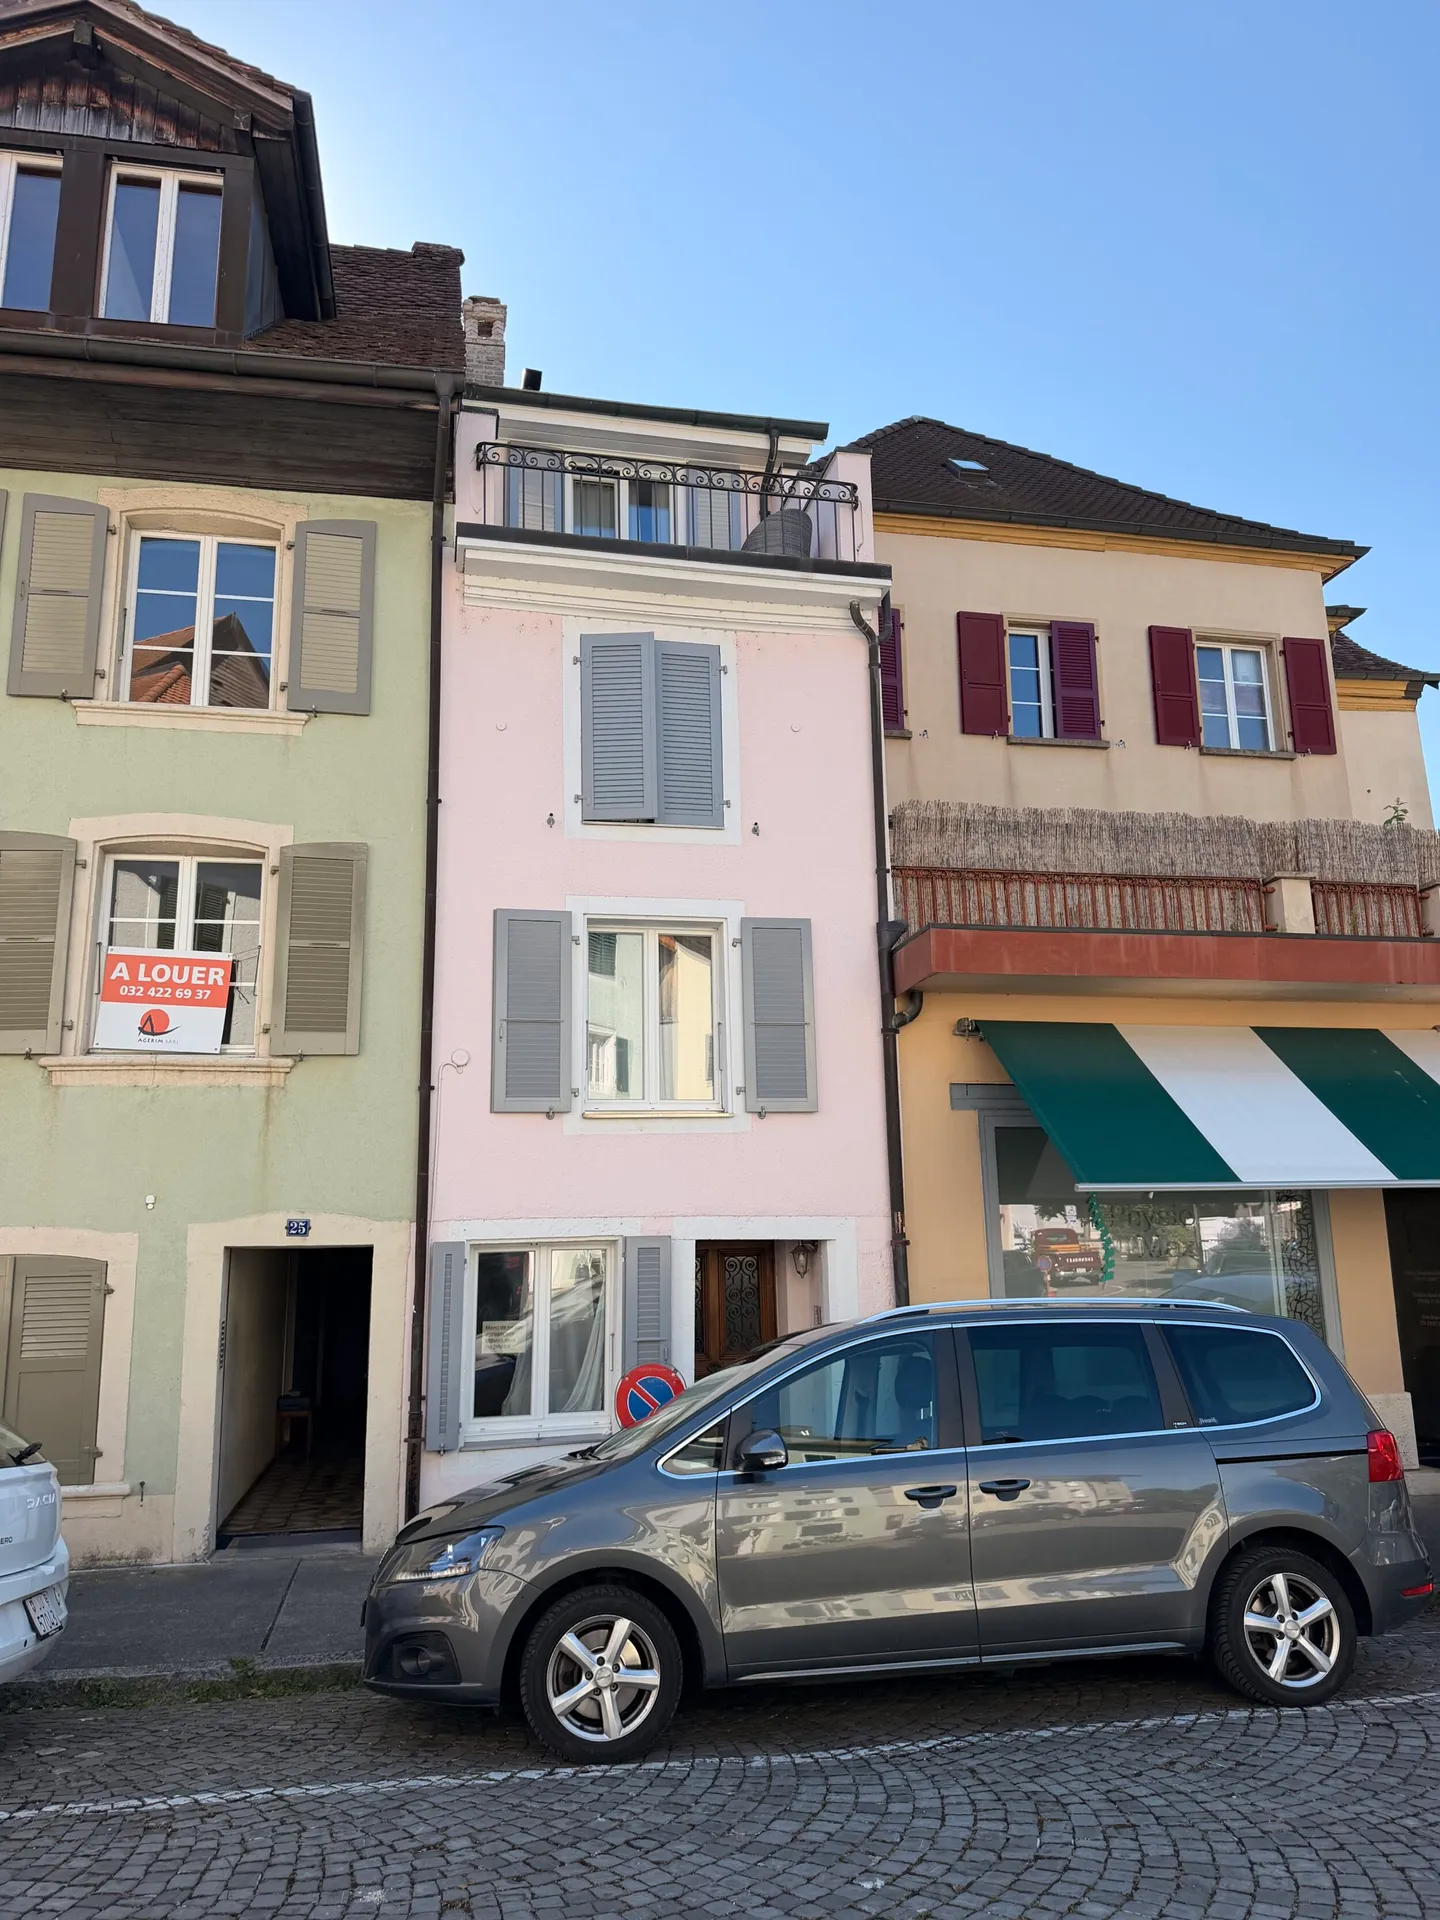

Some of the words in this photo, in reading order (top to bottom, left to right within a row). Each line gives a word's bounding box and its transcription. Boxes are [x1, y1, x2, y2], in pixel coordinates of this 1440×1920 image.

[111, 962, 130, 981] A
[138, 964, 225, 985] LOUER
[119, 985, 144, 997] 032
[147, 987, 172, 997] 422
[175, 988, 192, 999] 69
[194, 989, 211, 999] 37
[289, 1221, 306, 1234] 25
[27, 1493, 55, 1509] DACIA
